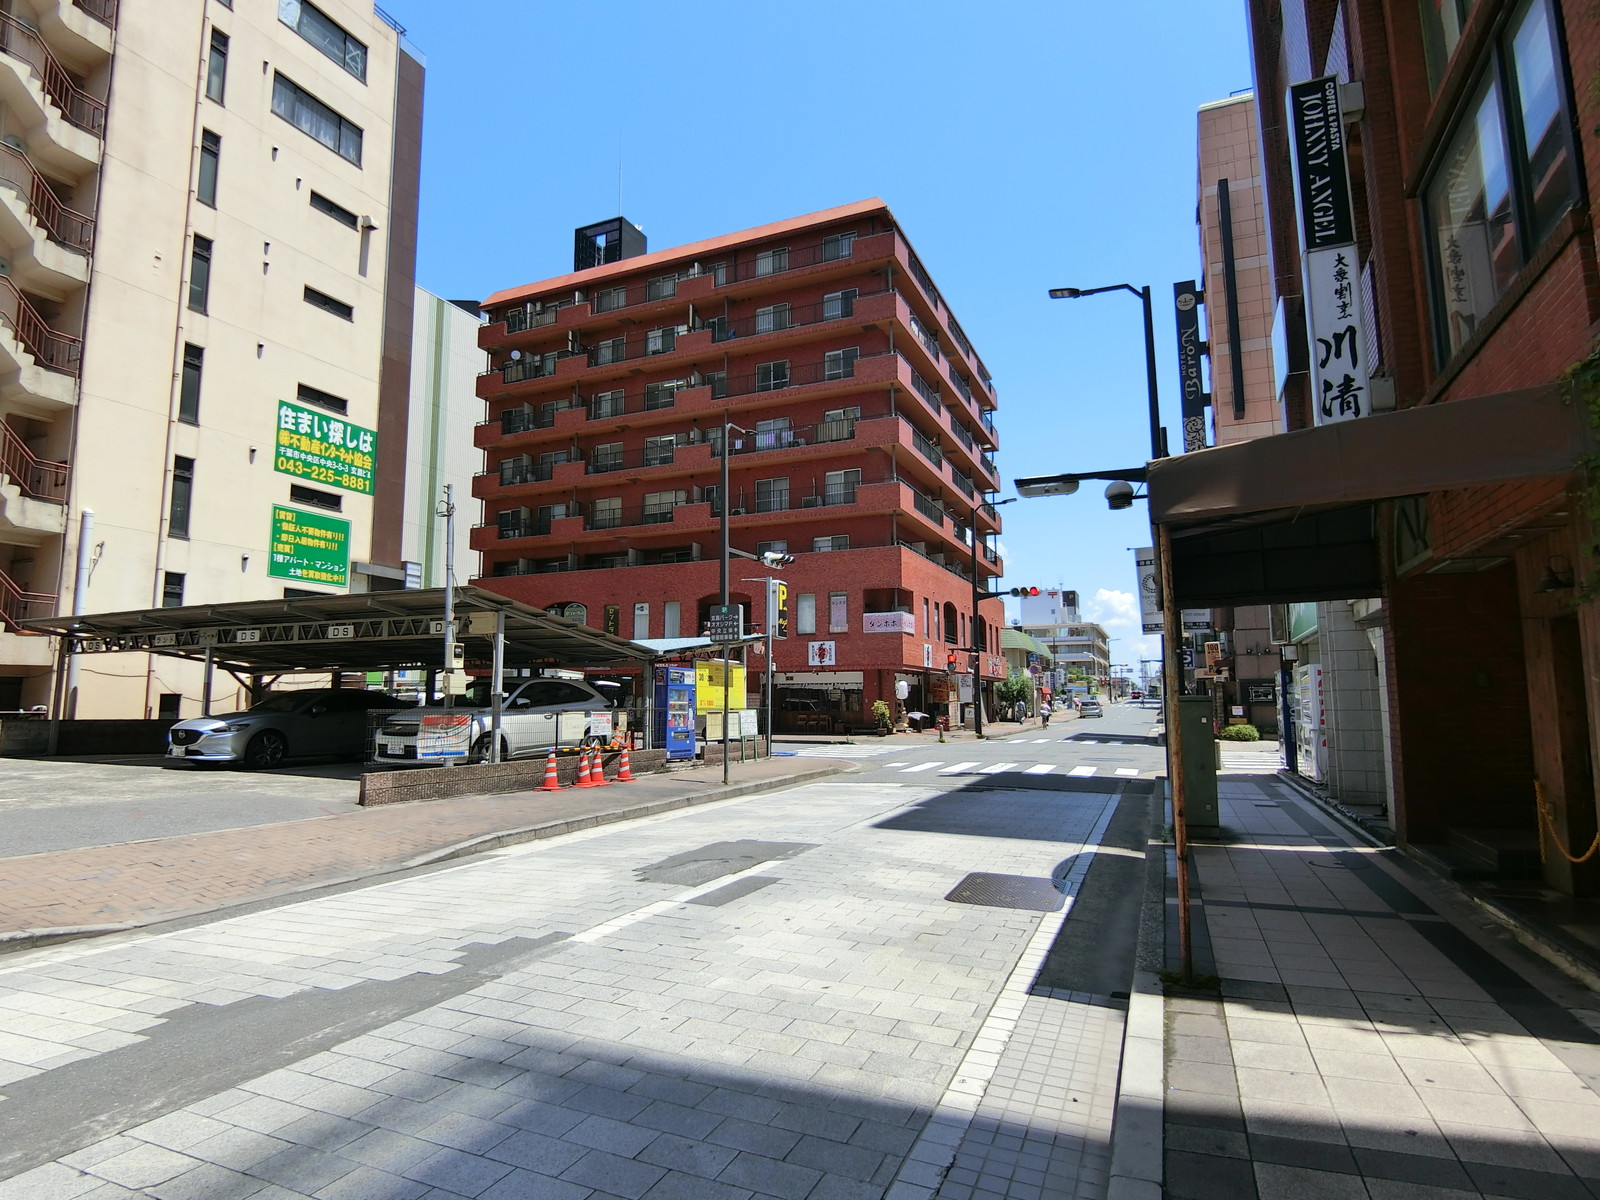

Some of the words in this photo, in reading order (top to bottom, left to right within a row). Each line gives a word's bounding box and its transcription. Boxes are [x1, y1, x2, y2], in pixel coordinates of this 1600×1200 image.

[1324, 81, 1337, 115] COFFEE
[1299, 91, 1329, 167] JOHNNY
[1329, 122, 1341, 151] PASTA
[1309, 174, 1336, 243] ANGEL
[1333, 252, 1352, 320] 大衆割烹
[1317, 325, 1364, 418] 川清
[280, 405, 373, 453] 住まい探しは
[278, 457, 371, 492] 043-225-8881
[241, 632, 256, 640] DS
[332, 627, 349, 636] DS
